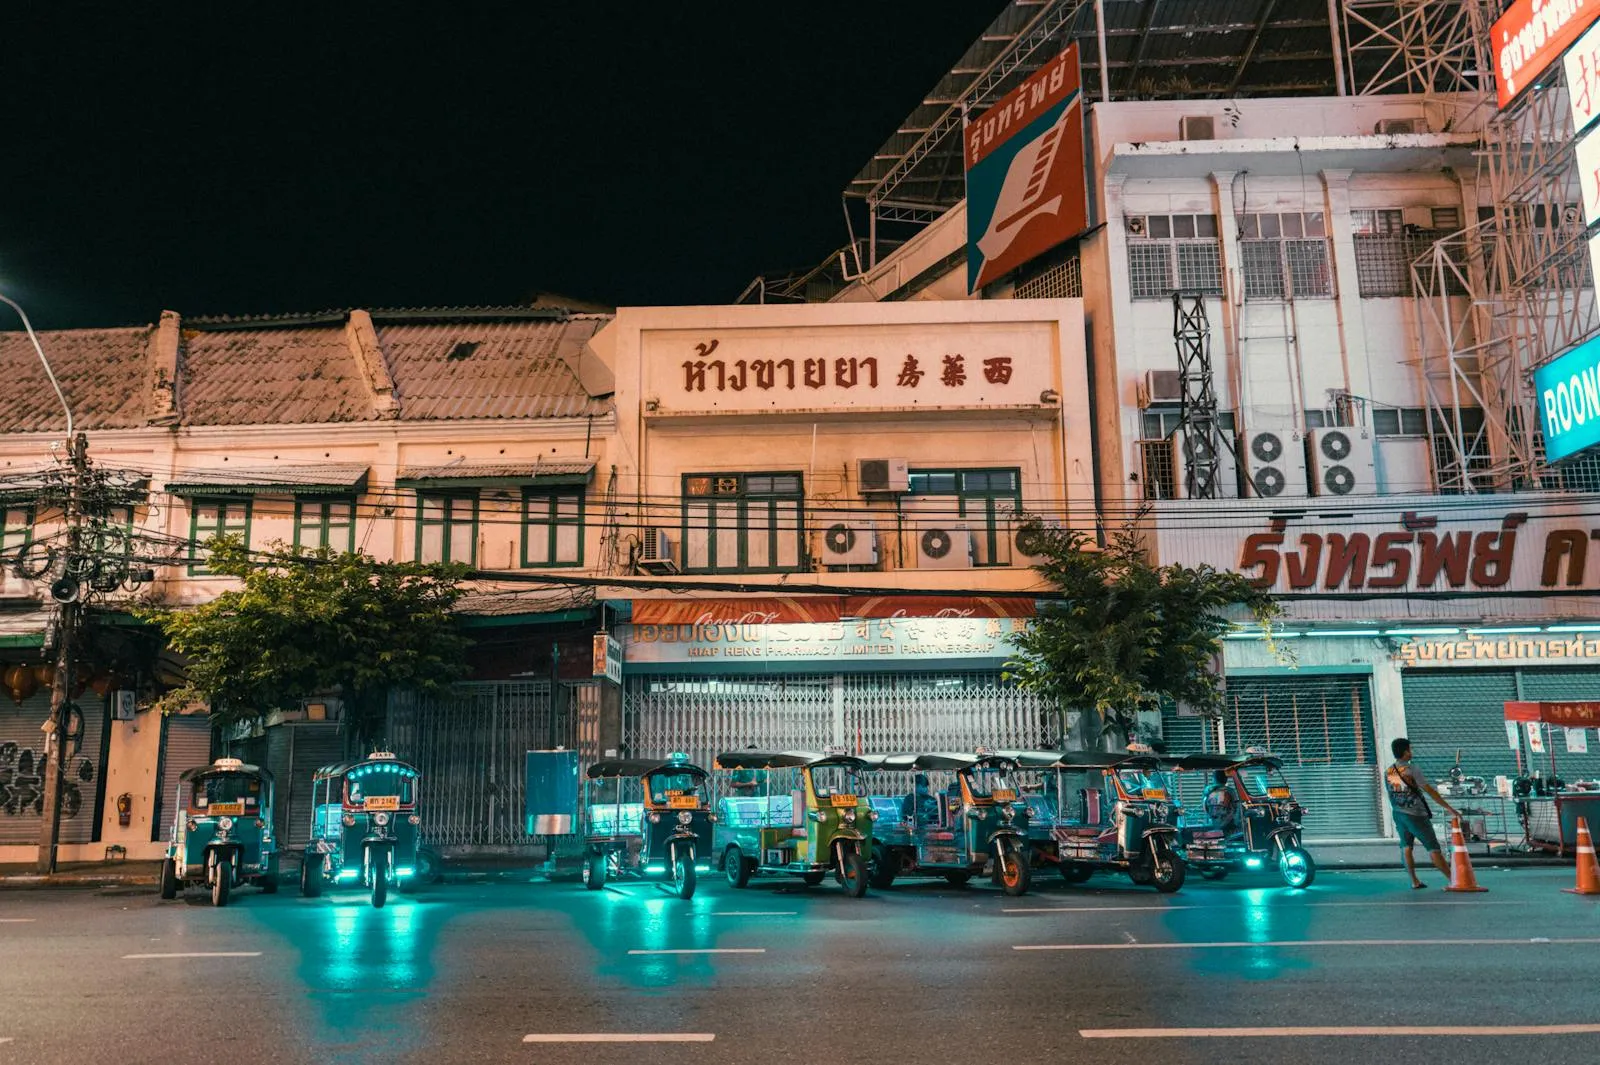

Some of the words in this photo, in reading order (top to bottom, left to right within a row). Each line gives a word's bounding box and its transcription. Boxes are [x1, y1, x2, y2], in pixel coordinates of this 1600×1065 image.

[682, 340, 878, 392] ห้างขายยา
[1543, 361, 1600, 438] ROON
[724, 646, 761, 657] HENG
[766, 645, 839, 657] PHARMACY
[843, 643, 896, 655] LIMITED
[901, 642, 995, 655] PARTNERSHIP
